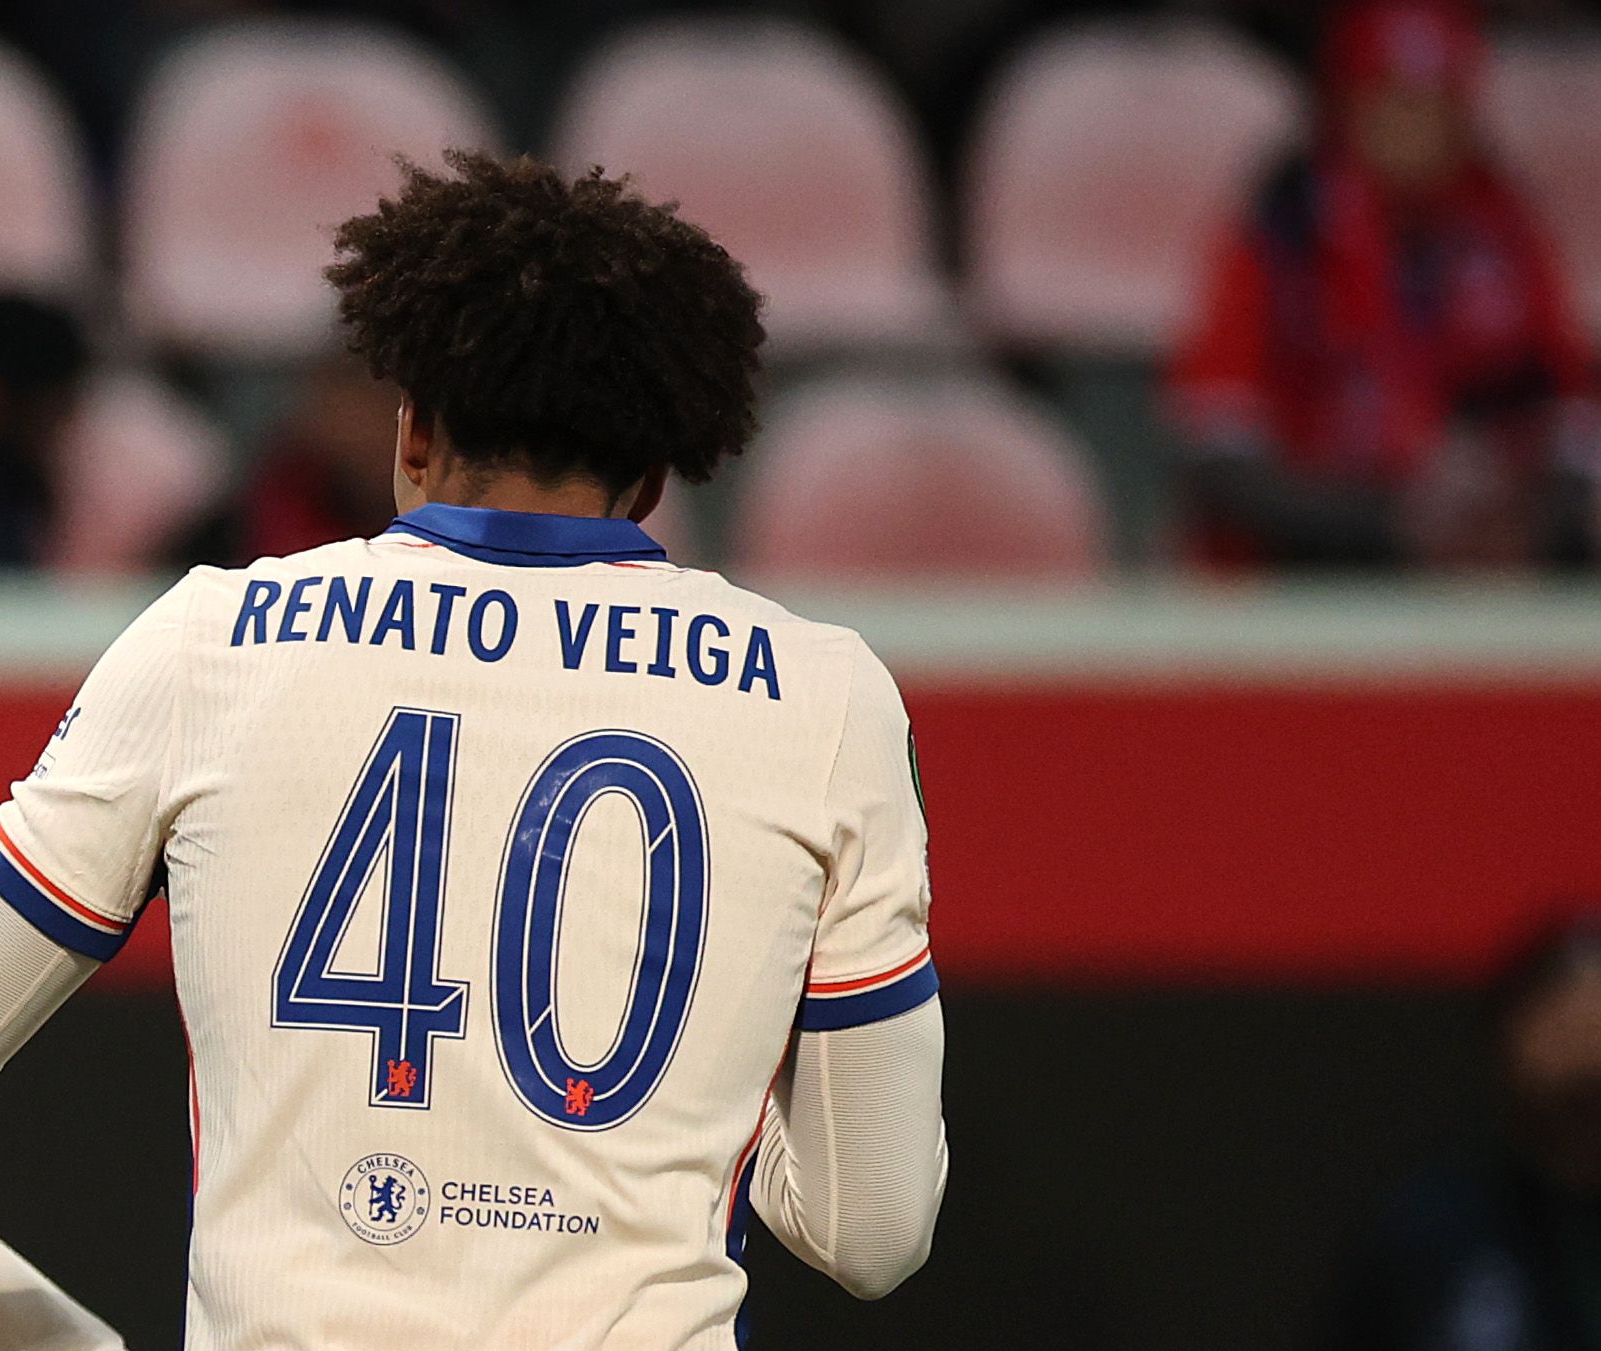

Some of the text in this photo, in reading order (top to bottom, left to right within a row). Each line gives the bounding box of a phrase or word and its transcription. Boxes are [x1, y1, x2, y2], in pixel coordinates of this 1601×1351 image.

[230, 576, 781, 700] RENATO VEIGA
[270, 706, 710, 1132] 40
[357, 1157, 415, 1177] CHELSEA
[441, 1181, 555, 1207] CHELSEA
[352, 1222, 390, 1241] FOOTBALL
[440, 1207, 600, 1234] FOUNDATION
